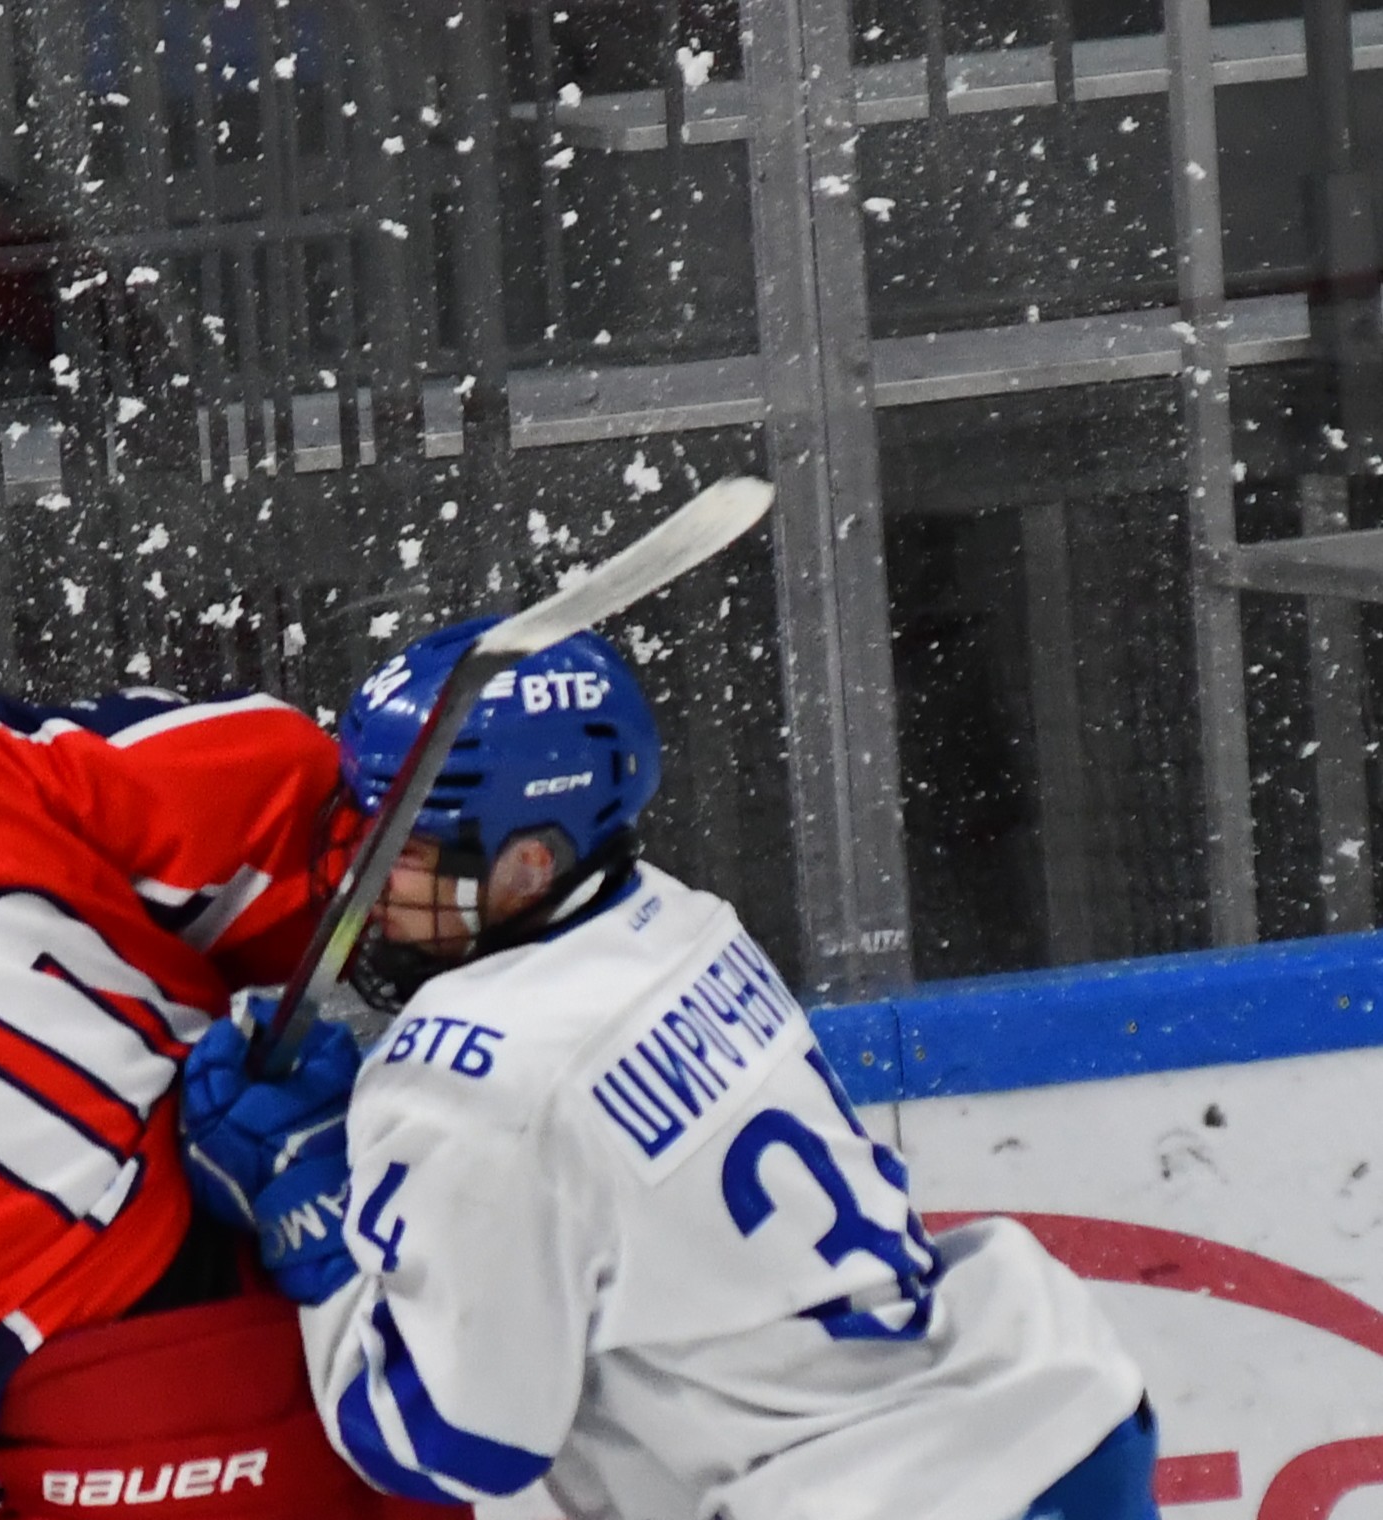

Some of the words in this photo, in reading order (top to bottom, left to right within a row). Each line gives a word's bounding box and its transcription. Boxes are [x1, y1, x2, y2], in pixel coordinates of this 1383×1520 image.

[361, 654, 411, 711] 34
[524, 771, 593, 798] CCM
[385, 1015, 506, 1079] ВТБ
[344, 1161, 410, 1274] 4
[42, 1447, 268, 1506] BAUER
